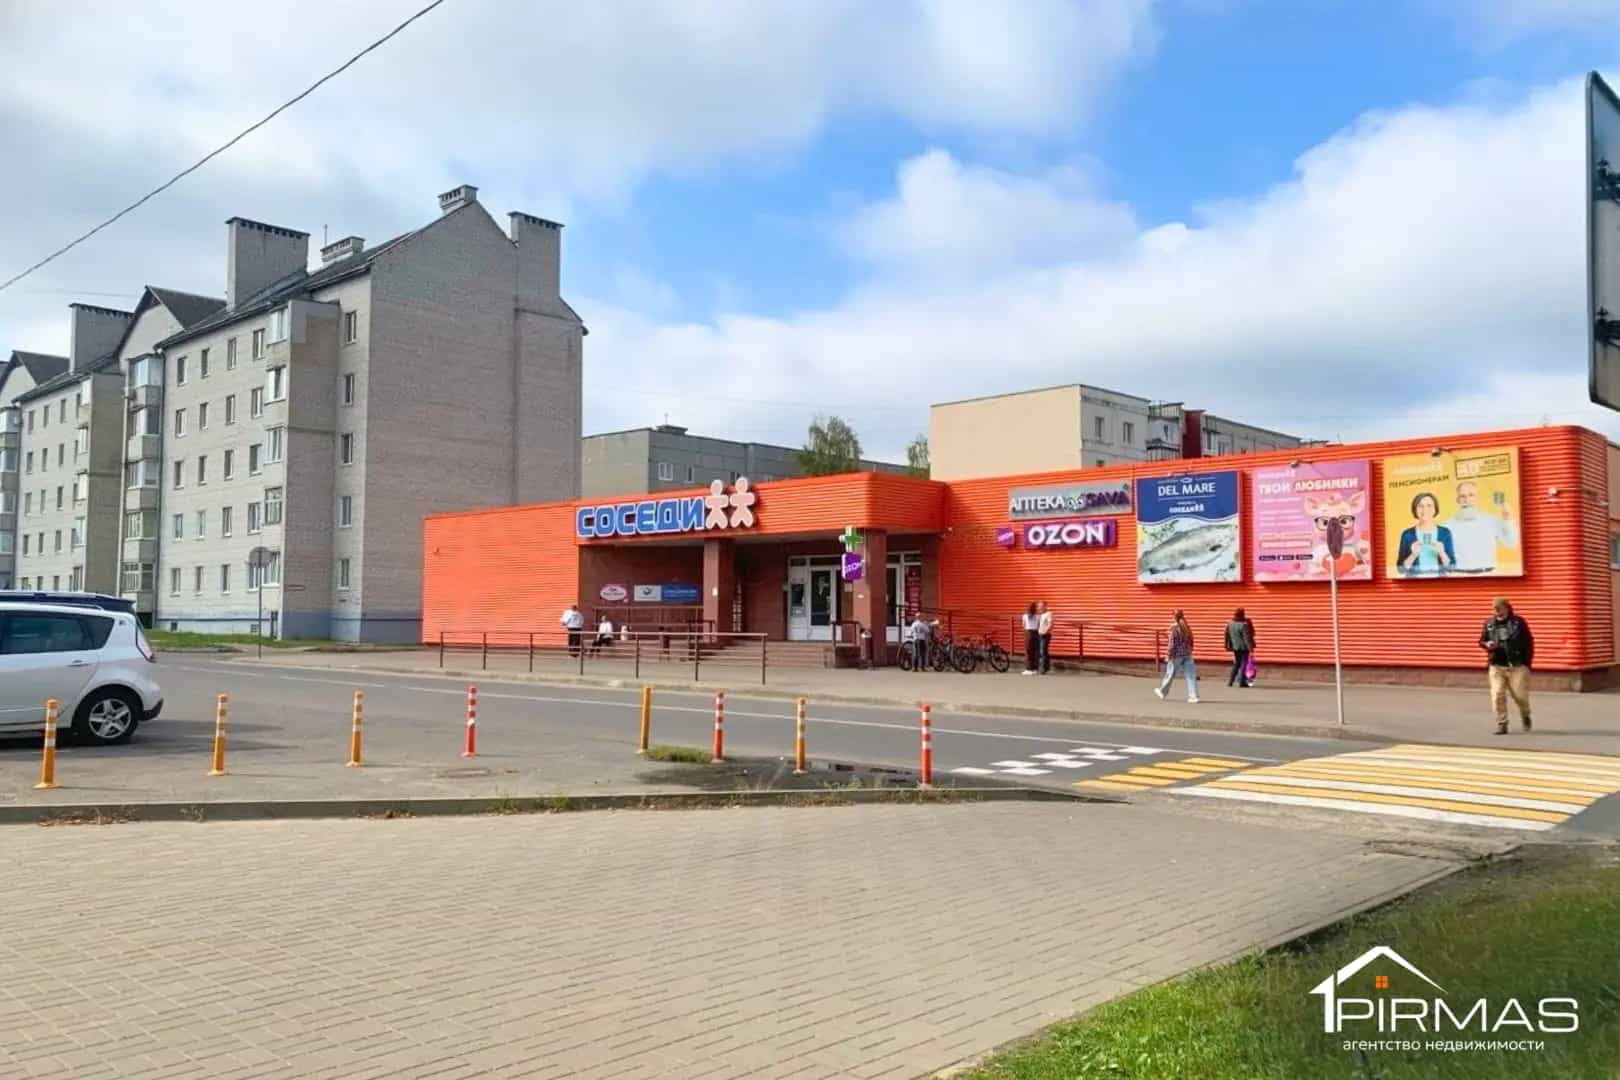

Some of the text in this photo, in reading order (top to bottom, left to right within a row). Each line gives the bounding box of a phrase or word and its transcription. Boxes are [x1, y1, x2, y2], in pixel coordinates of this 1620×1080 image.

[1157, 482, 1216, 496] DEL MARE
[1010, 495, 1065, 511] АПТЕКА
[576, 495, 705, 537] СОСЕДИ
[1027, 522, 1105, 545] OZON
